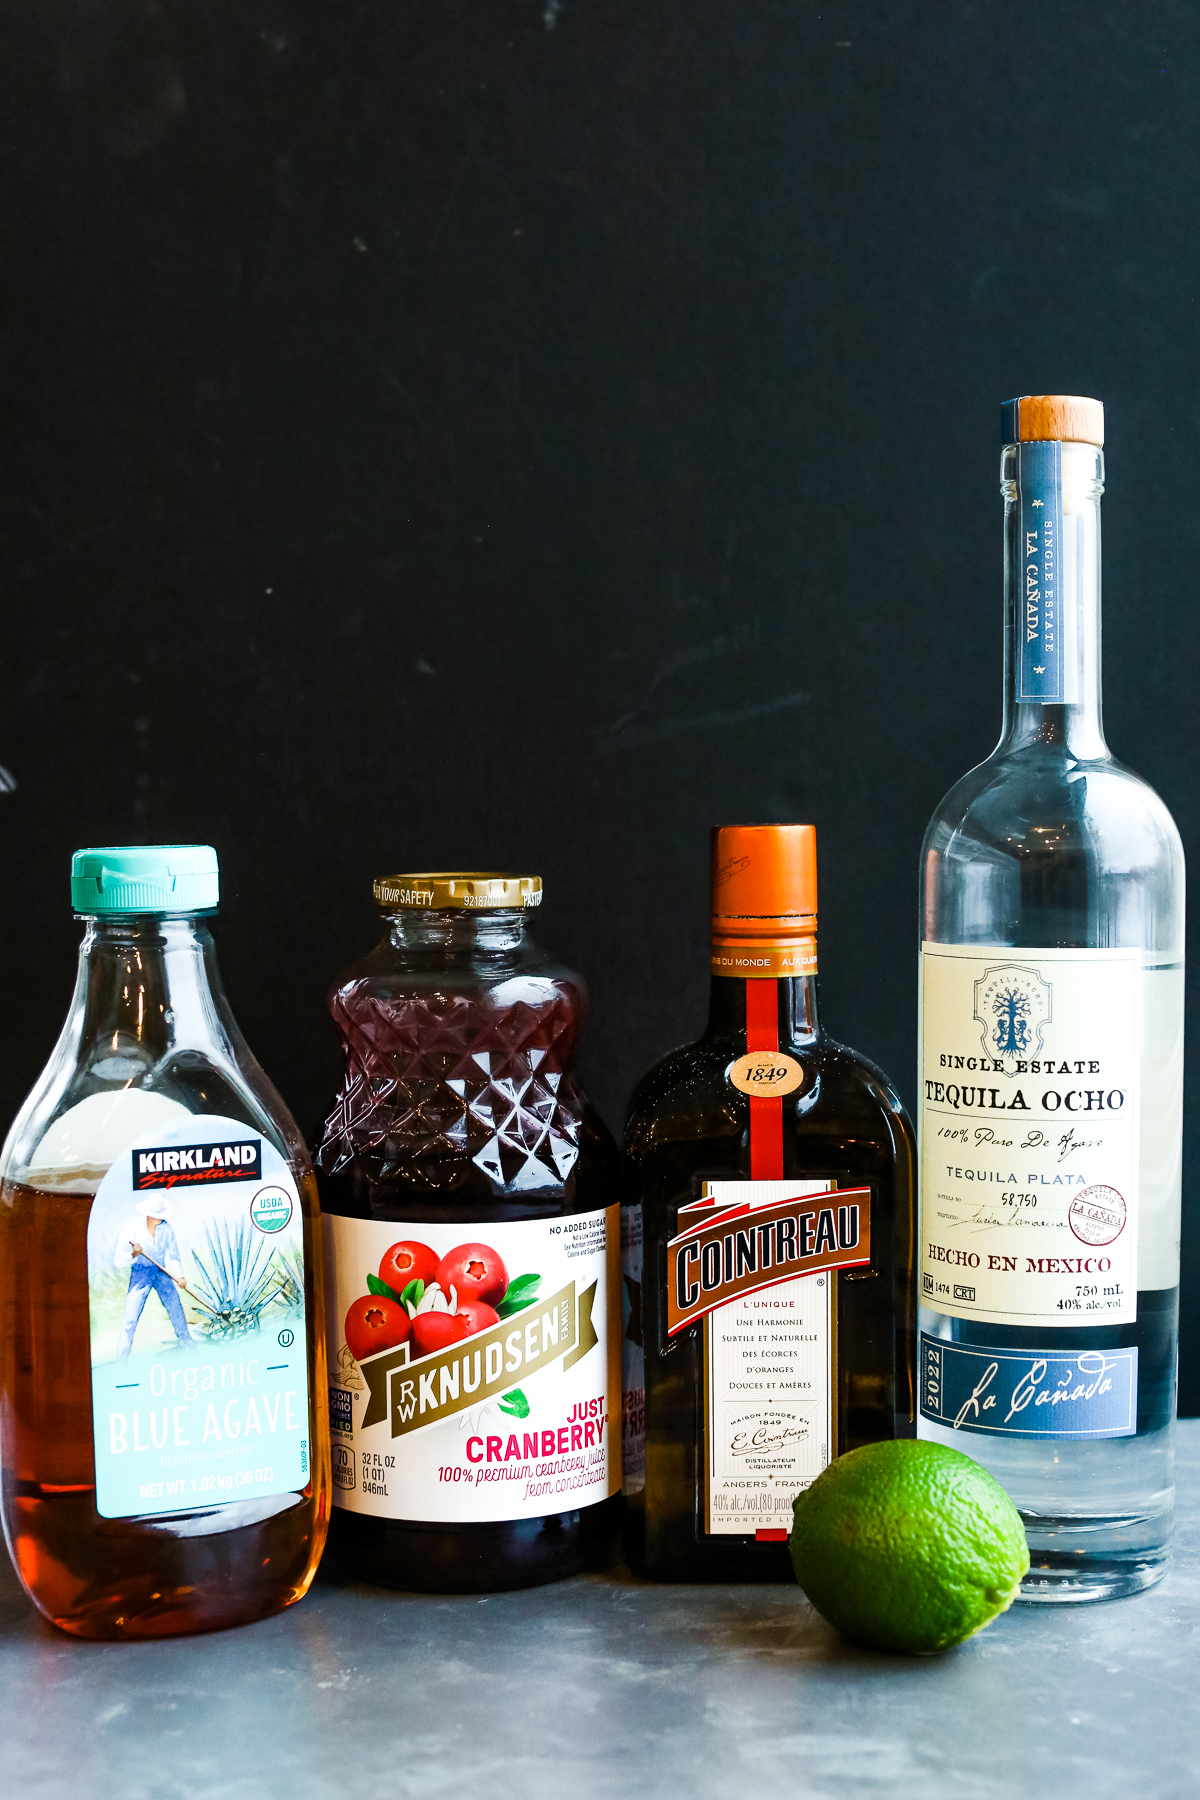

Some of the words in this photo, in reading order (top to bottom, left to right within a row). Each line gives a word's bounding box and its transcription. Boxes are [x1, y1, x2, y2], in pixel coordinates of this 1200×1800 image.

[1026, 531, 1038, 557] LA
[1044, 520, 1053, 581] SINGLE
[1026, 564, 1041, 643] CAÑADA
[1044, 590, 1054, 652] ESTATE
[381, 886, 400, 902] YOUR
[400, 889, 435, 906] SAFETY
[722, 958, 733, 966] DU
[736, 958, 771, 966] MONDE
[782, 958, 802, 966] AUX
[746, 1067, 788, 1082] 1849
[940, 1054, 1004, 1072] SINGLE
[1016, 1060, 1100, 1074] ESTATE
[925, 1080, 1032, 1110] TEQUILA
[1041, 1089, 1125, 1112] OCHO
[937, 1127, 969, 1145] 100%
[974, 1127, 1014, 1148] Puro
[1020, 1130, 1050, 1149] De
[1057, 1127, 1103, 1163] Agave
[138, 1145, 257, 1174] KIRKLAND
[139, 1167, 257, 1190] Signature
[946, 1166, 1018, 1184] TEQUILA
[1028, 1174, 1087, 1185] PLATA
[260, 1197, 284, 1209] USDA
[257, 1210, 287, 1222] ORGANIC
[1072, 1202, 1084, 1214] LA
[1088, 1208, 1121, 1226] CAÑADA
[550, 1226, 562, 1236] NO
[564, 1222, 588, 1233] ADDED
[589, 1216, 606, 1228] SUGAR
[676, 1204, 860, 1310] COINTREAU
[928, 1243, 980, 1268] HECHO
[988, 1254, 1018, 1272] EN
[1026, 1258, 1111, 1274] MEXICO
[936, 1282, 950, 1294] 1474
[956, 1288, 974, 1298] CRT
[1076, 1286, 1098, 1296] 750
[1103, 1284, 1124, 1296] mL
[743, 1301, 796, 1309] L'UNIQUE
[1056, 1298, 1082, 1310] 40%
[418, 1306, 559, 1415] KNUDSEN
[561, 1298, 569, 1342] FAMILY
[150, 1356, 259, 1401] Organic
[928, 1350, 940, 1410] 2022
[331, 1390, 350, 1402] NON
[953, 1362, 998, 1430] La
[1003, 1351, 1117, 1424] Cañada
[331, 1402, 350, 1412] GMO
[566, 1396, 605, 1424] JUST
[108, 1405, 191, 1454] BLUE
[202, 1390, 300, 1443] AGAVE
[730, 1412, 761, 1426] MAISON
[160, 1454, 172, 1466] All
[173, 1450, 210, 1467] purpose
[210, 1444, 254, 1460] sweetener
[338, 1448, 348, 1466] 70
[362, 1452, 372, 1465] 32
[374, 1454, 382, 1466] FL
[384, 1456, 396, 1468] OZ
[362, 1466, 368, 1480] (1
[372, 1468, 385, 1482] QT)
[438, 1466, 474, 1482] 100%
[476, 1464, 534, 1488] premium
[536, 1454, 586, 1478] cranberry
[586, 1448, 606, 1469] juice
[140, 1482, 165, 1499] NET
[166, 1479, 187, 1496] WT
[190, 1476, 216, 1492] 1.02
[217, 1474, 233, 1491] kg
[235, 1470, 254, 1488] (36
[255, 1466, 274, 1484] OZ)
[362, 1481, 389, 1496] 946mL
[522, 1480, 554, 1501] from
[556, 1466, 606, 1493] concentrate
[714, 1494, 728, 1510] 40%
